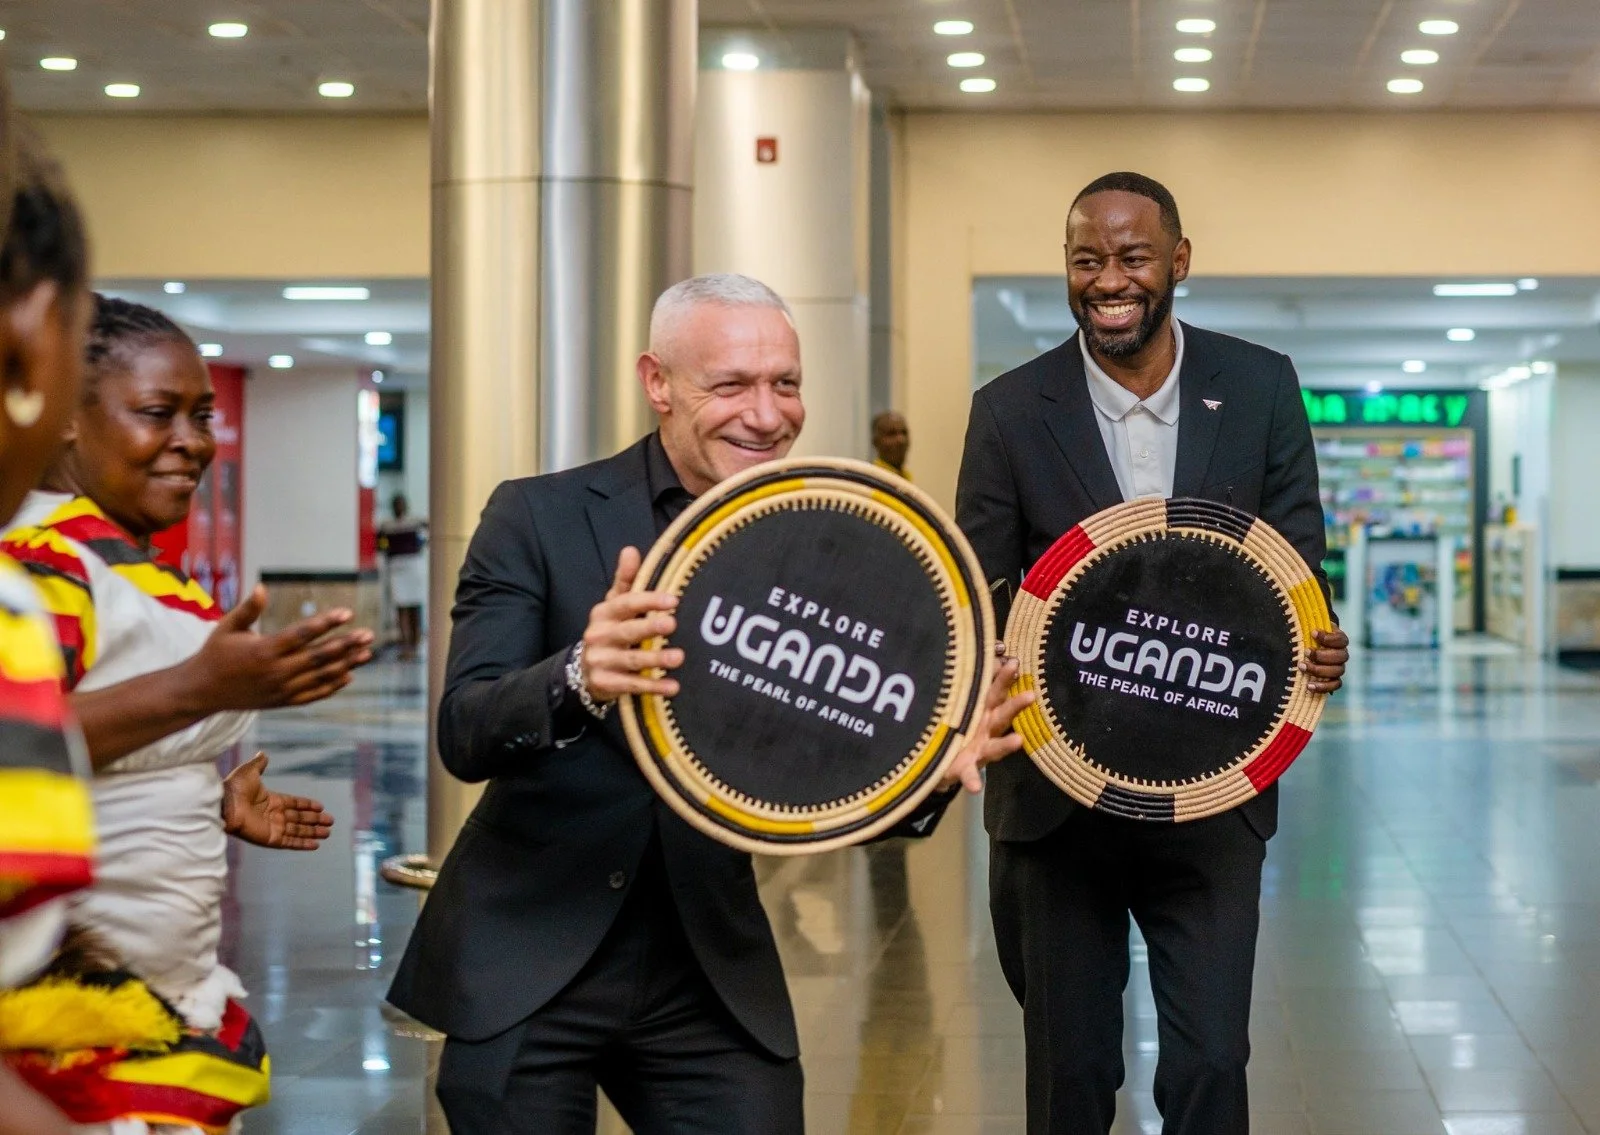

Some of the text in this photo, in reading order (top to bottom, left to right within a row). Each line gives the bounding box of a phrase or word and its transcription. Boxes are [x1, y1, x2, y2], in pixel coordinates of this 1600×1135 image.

[767, 586, 885, 649] EXPLORE
[1125, 608, 1231, 647] EXPLORE
[700, 595, 915, 723] UGANDA
[1070, 622, 1266, 703] UGANDA
[1078, 670, 1239, 719] THE PEARL OF AFRICA
[709, 659, 874, 738] THE PEARL OF AFRICA
